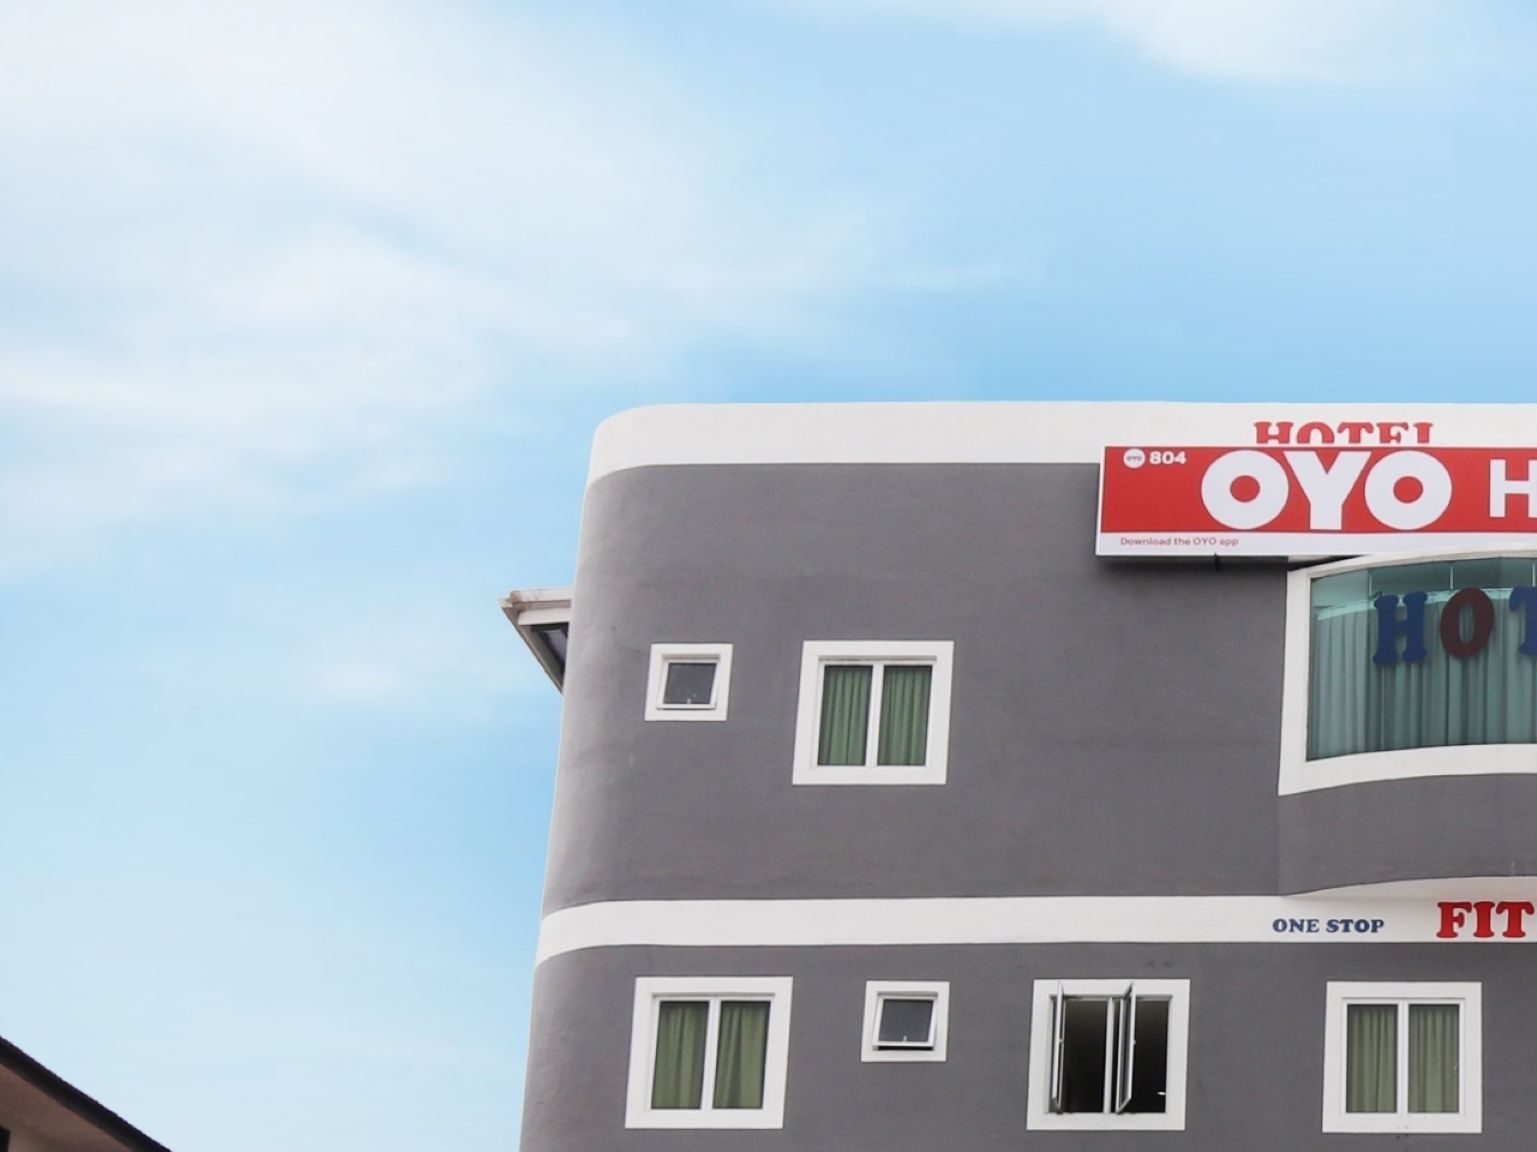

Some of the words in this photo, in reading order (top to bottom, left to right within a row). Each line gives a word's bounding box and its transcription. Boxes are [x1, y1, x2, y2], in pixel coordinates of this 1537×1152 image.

[1149, 451, 1187, 465] 804
[1201, 450, 1453, 531] OYO
[1120, 537, 1171, 546] Download
[1174, 537, 1190, 546] the
[1193, 537, 1216, 546] OYO
[1219, 539, 1238, 547] app
[1272, 918, 1319, 934] ONE
[1326, 918, 1385, 934] STOP
